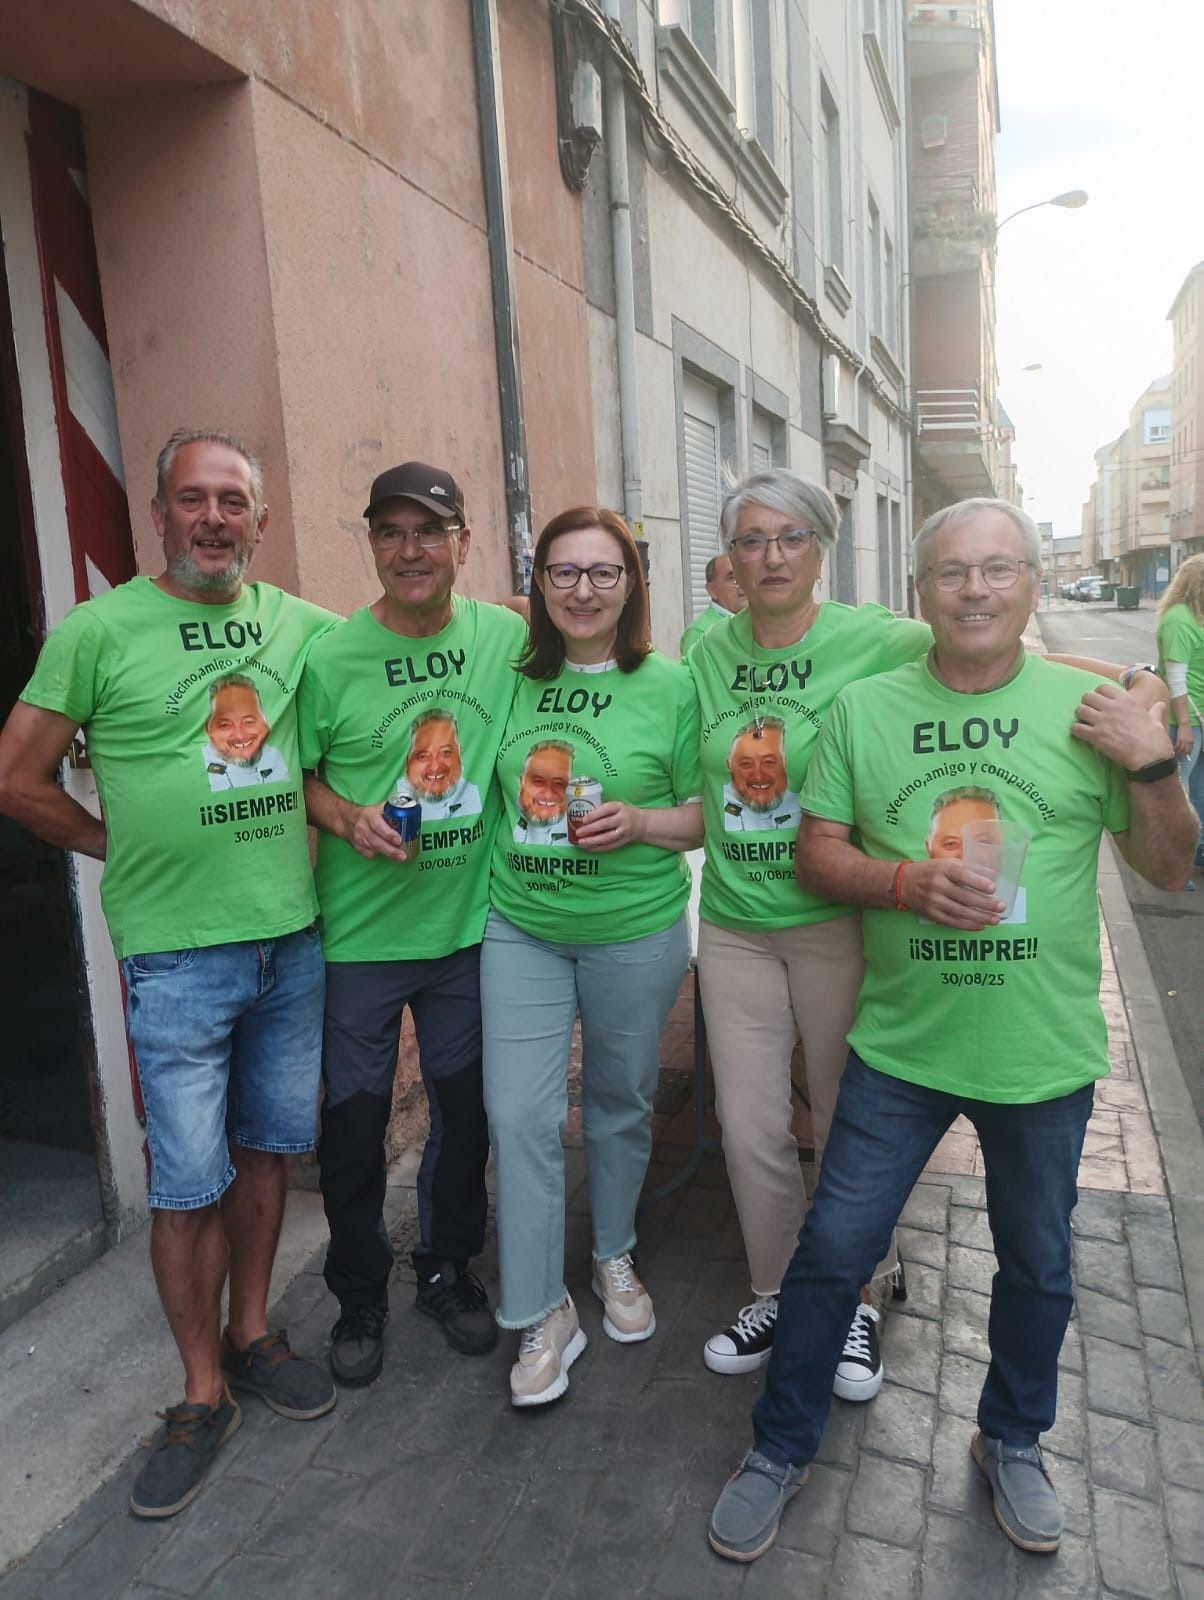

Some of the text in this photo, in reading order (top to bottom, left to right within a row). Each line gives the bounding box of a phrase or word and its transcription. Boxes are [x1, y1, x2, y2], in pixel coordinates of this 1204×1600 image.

[179, 621, 263, 651] ELOY
[384, 648, 466, 687] ELOY
[730, 659, 813, 693] ELOY
[537, 687, 612, 718] ELOY
[565, 721, 571, 733] y
[912, 717, 1019, 754] ELOY
[969, 761, 978, 775] y
[981, 762, 1056, 822] compañero!!
[234, 823, 285, 843] 30/08/25
[421, 820, 485, 852] EMPRE!!
[418, 854, 467, 872] 30/08/25
[909, 936, 1038, 962] ¡¡SIEMPRE!!
[940, 972, 1005, 986] 30/08/25
